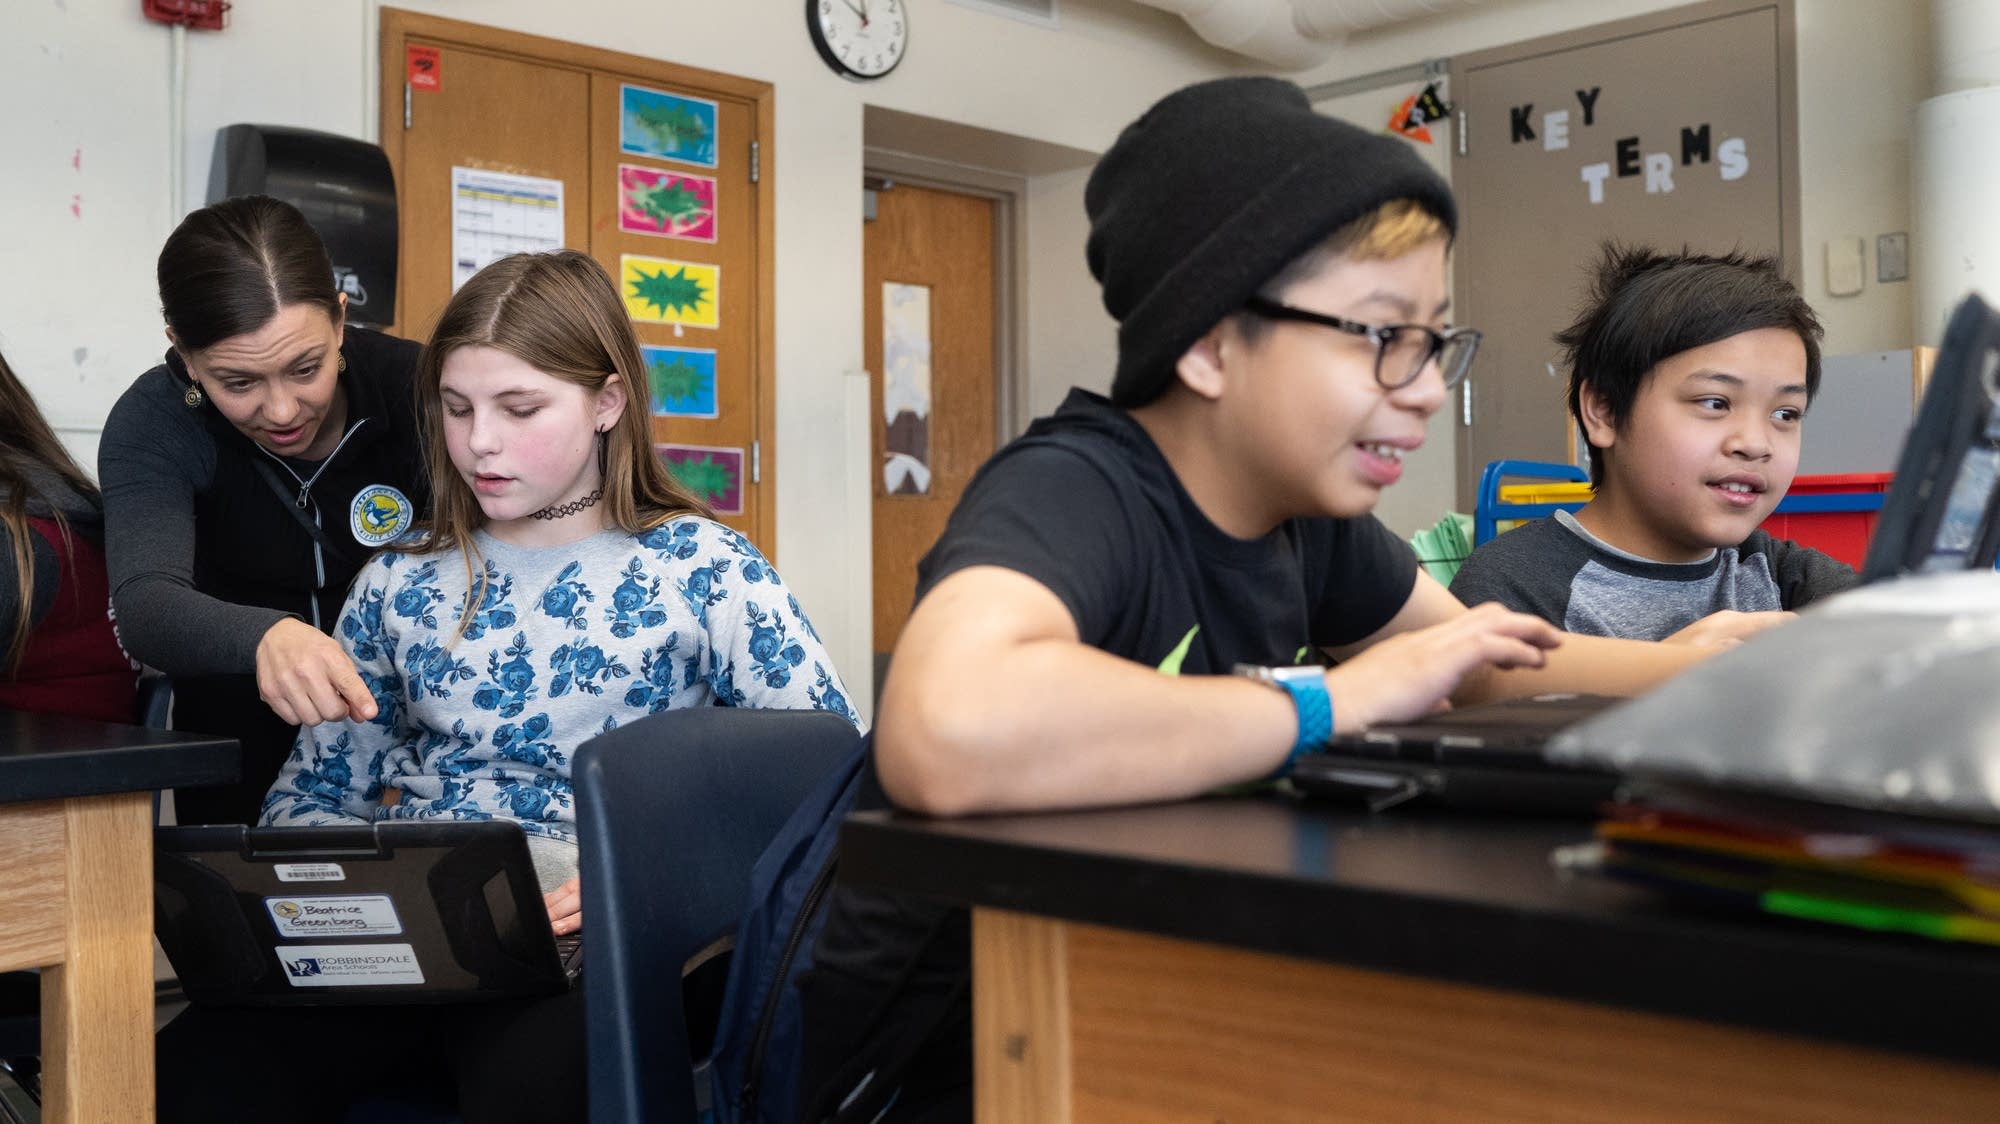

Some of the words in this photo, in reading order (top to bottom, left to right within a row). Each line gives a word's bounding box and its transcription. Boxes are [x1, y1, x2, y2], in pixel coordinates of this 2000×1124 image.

[1510, 86, 1601, 151] KEY
[1581, 123, 1749, 204] TERMS
[304, 906, 363, 915] Beatrice
[317, 955, 412, 965] ROBBINSDALE
